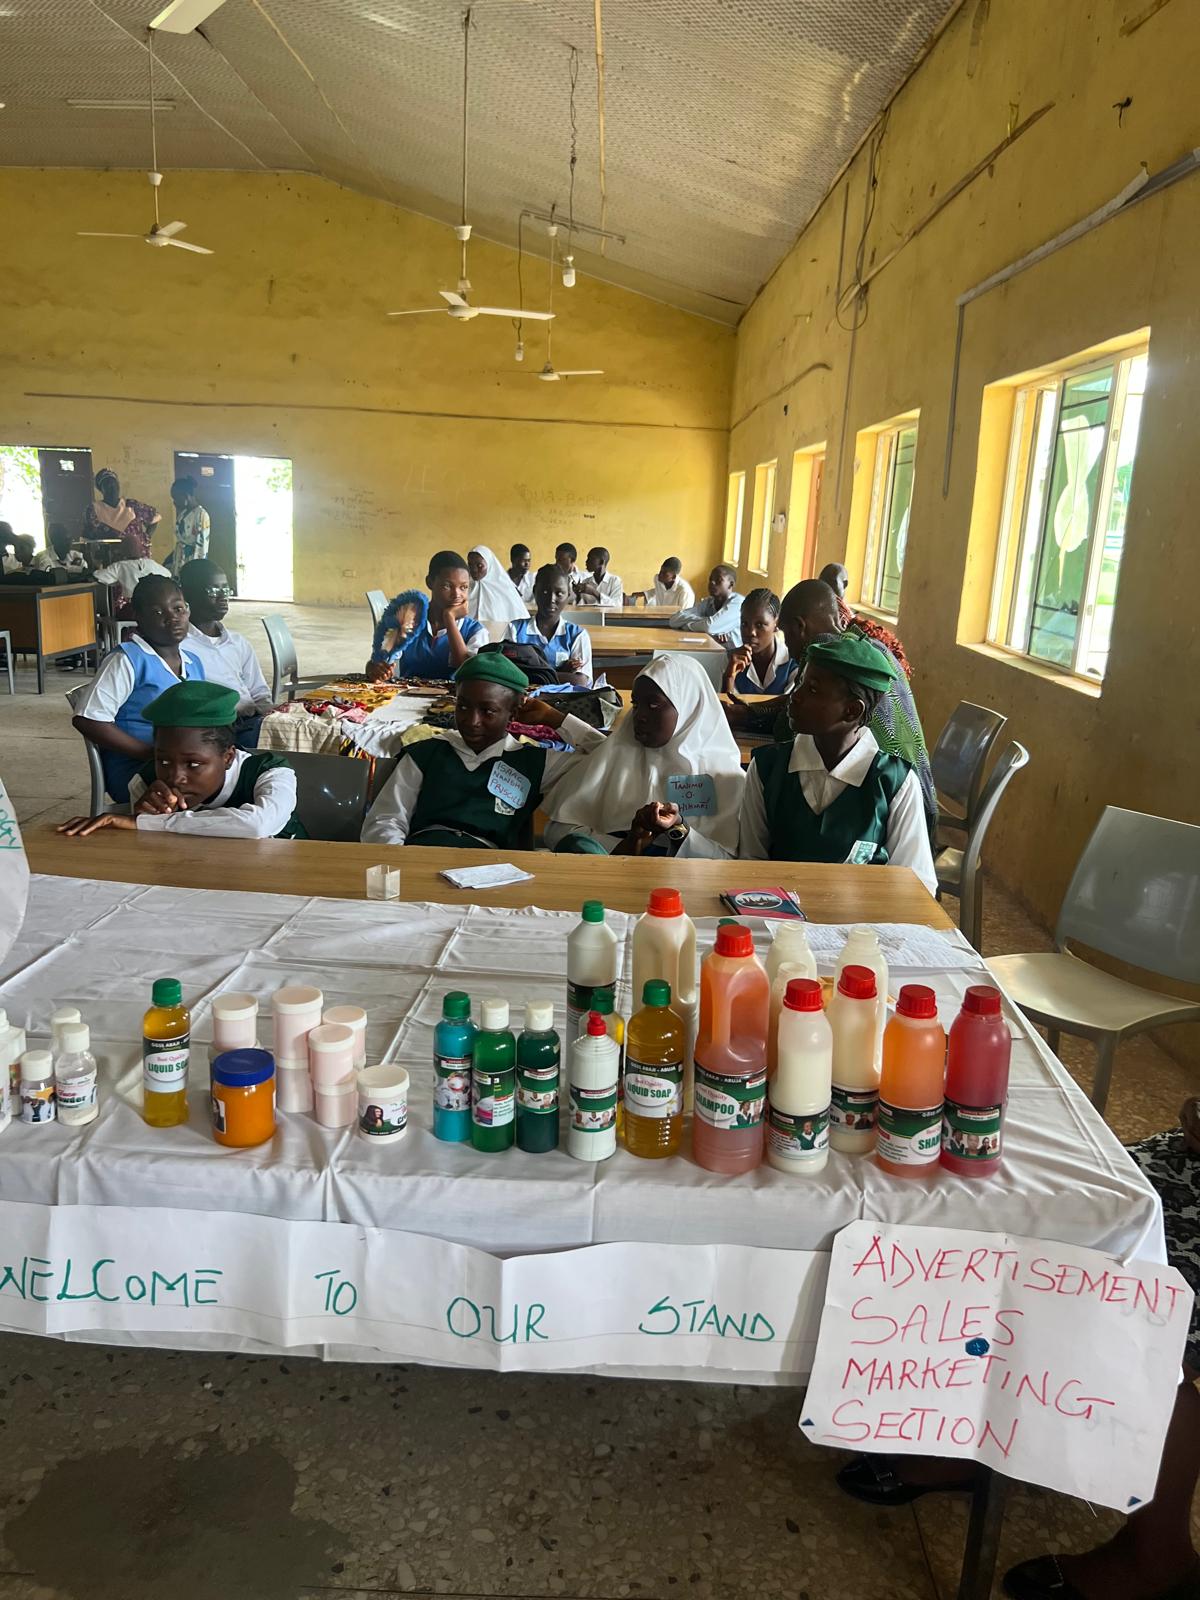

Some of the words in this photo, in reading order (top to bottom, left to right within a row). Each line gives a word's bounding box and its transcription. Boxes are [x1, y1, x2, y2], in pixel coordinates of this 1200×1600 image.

[148, 1062, 174, 1074] LIQUID
[626, 1082, 649, 1098] LIQUID
[650, 1089, 672, 1099] SOAP
[696, 1090, 735, 1115] SHAMPOO
[0, 1256, 224, 1307] WELCOME
[314, 1269, 358, 1316] TO
[446, 1296, 550, 1344] OUR
[638, 1295, 776, 1342] STAND
[852, 1235, 1186, 1322] ADVERTISEMENT
[850, 1296, 1025, 1347] SALES
[841, 1354, 1116, 1420] MARKETING
[822, 1399, 1019, 1460] SECTION
